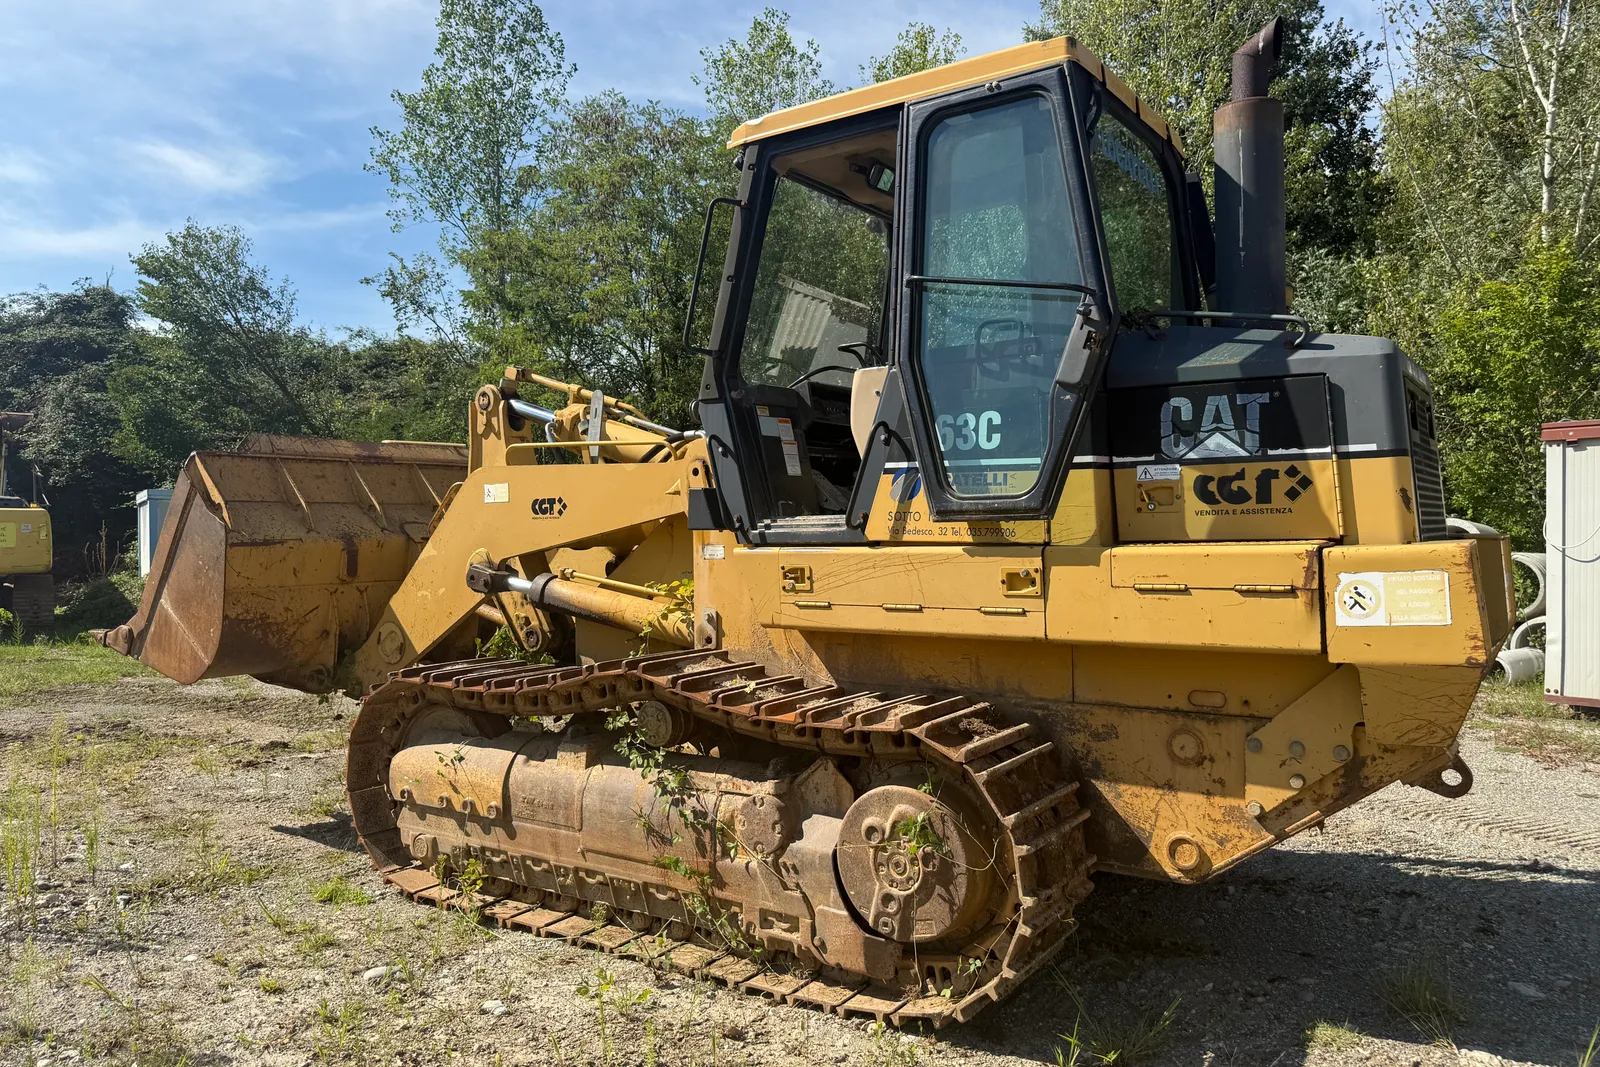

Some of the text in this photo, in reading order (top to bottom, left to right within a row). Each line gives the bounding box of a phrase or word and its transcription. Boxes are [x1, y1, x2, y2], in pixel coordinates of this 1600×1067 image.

[1160, 392, 1270, 459] CAT
[531, 498, 556, 515] CGT
[1240, 507, 1293, 515] ASSISTENZA
[887, 510, 922, 522] SOTTO
[887, 525, 1016, 538] Via Bedesco, 32 Tel. 035.799906
